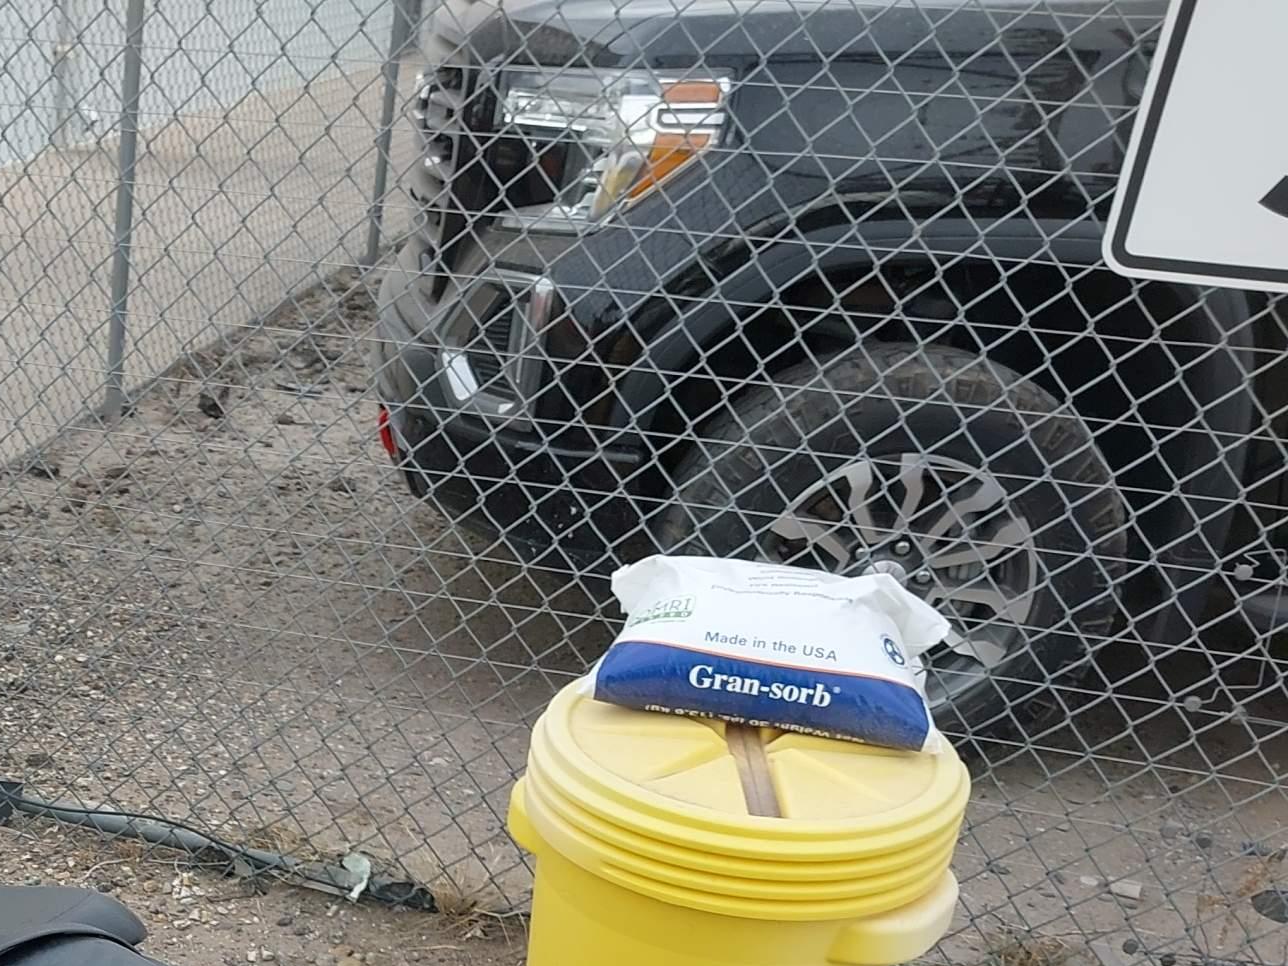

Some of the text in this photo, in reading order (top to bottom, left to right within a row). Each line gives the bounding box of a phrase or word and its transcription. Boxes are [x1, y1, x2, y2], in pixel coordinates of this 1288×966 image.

[704, 631, 838, 662] Made in the USA
[688, 664, 832, 708] Gran-sorb
